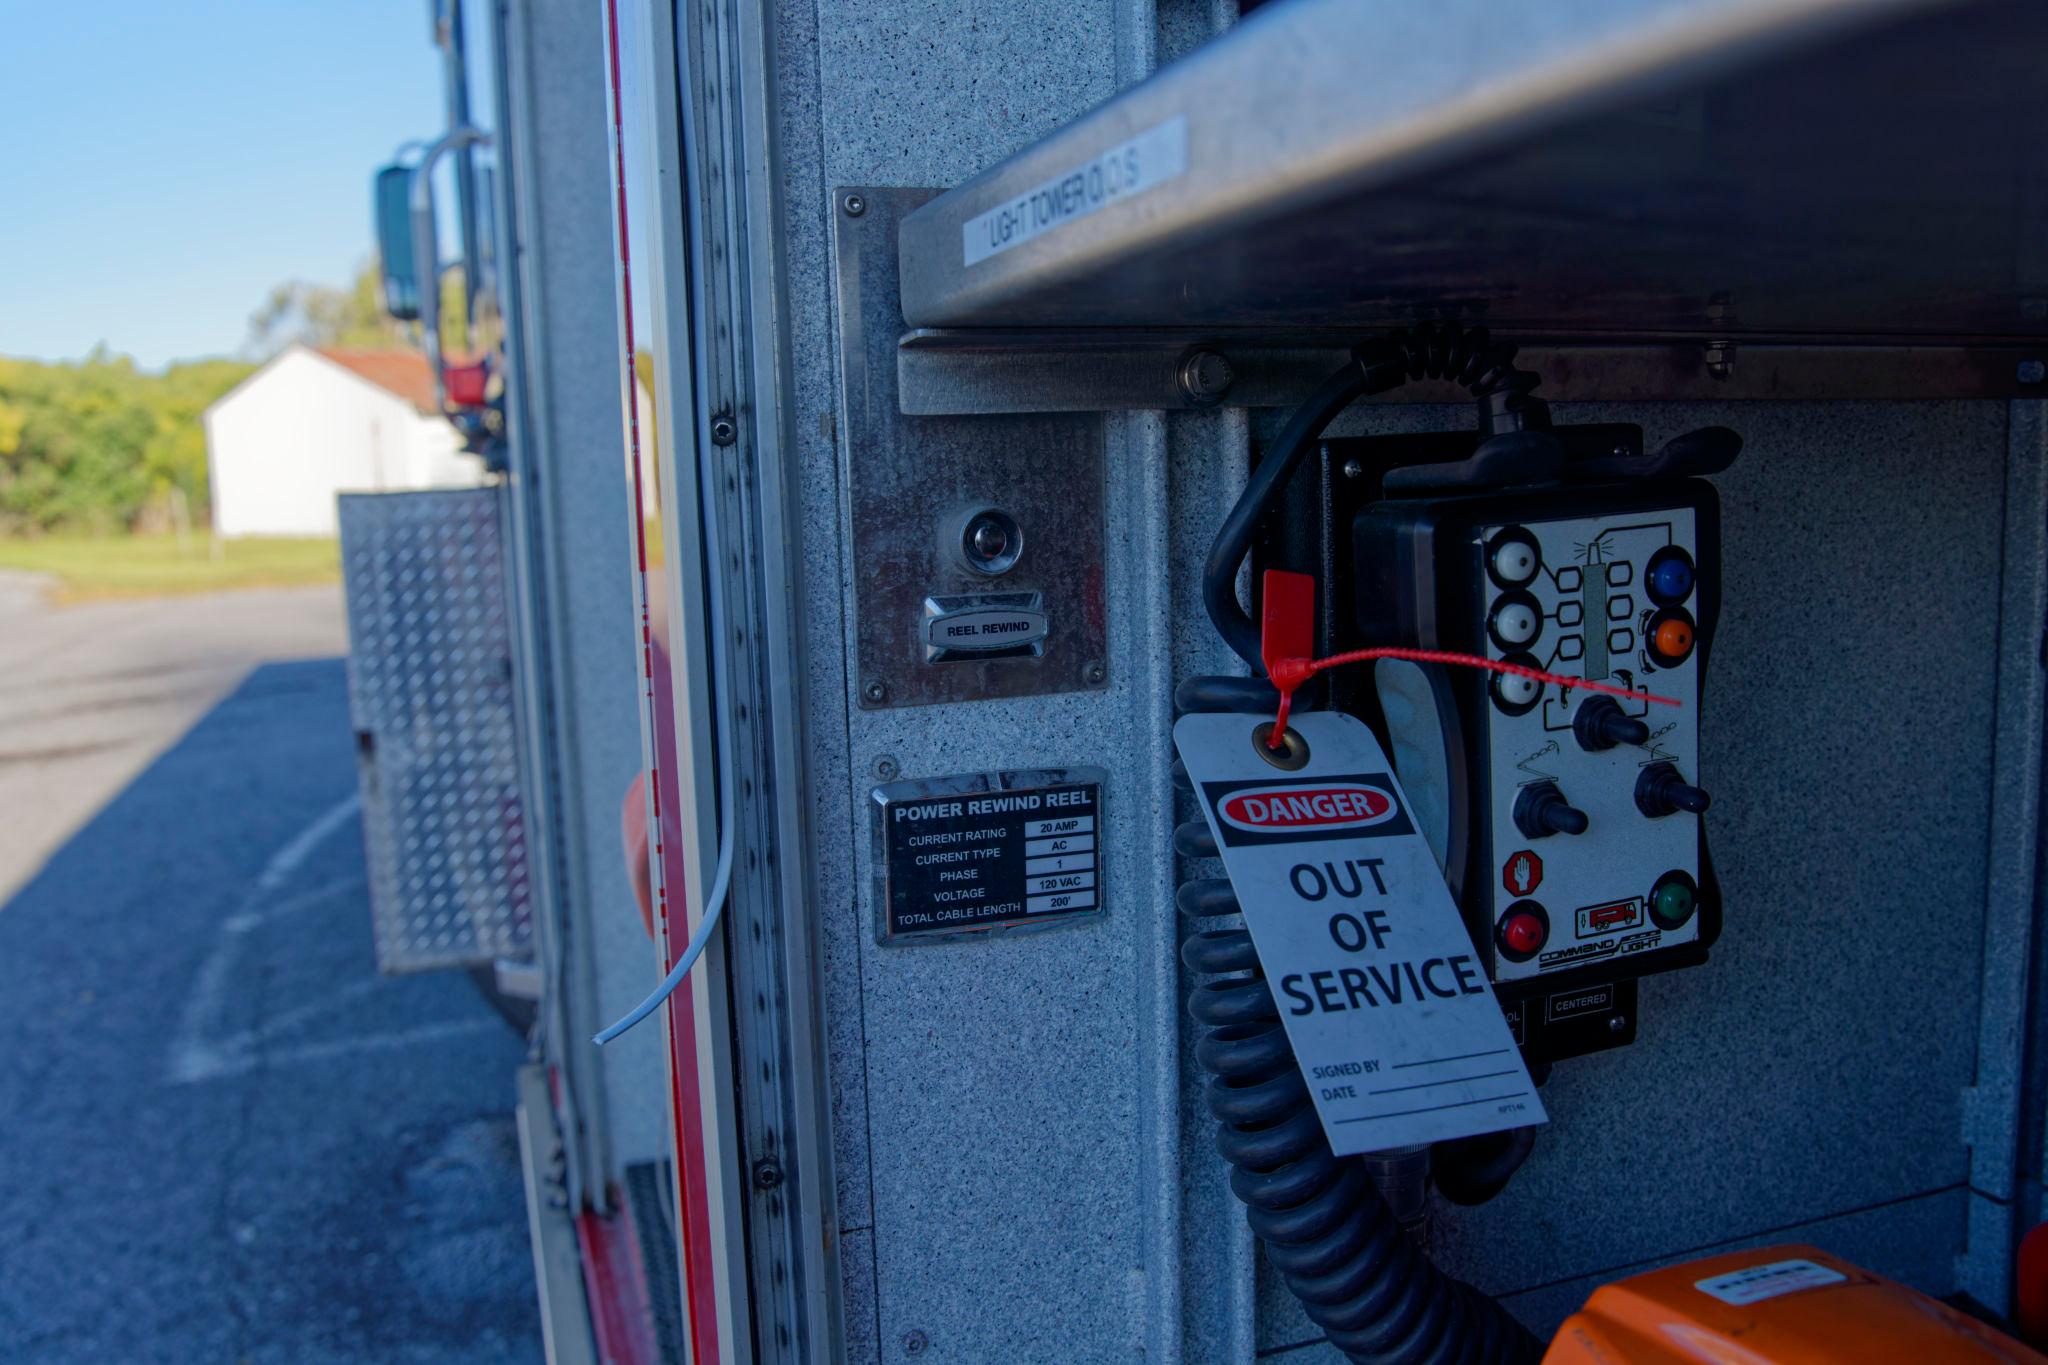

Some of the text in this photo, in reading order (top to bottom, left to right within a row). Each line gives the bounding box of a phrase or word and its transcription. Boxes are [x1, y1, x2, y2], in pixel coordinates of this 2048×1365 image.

[1030, 172, 1086, 226] TOWER
[948, 621, 1030, 637] REEL REWIND
[895, 790, 1091, 822] POWER REWIND REEL
[1241, 792, 1376, 824] DANGER
[1040, 820, 1078, 833] 20 AMP
[908, 828, 1007, 847] CURRENT RATING
[1051, 840, 1067, 850] AC
[915, 848, 1001, 866] CURRENT TYPE
[940, 869, 978, 882] PHASE
[1039, 876, 1081, 890] 120 VAC
[1288, 857, 1388, 902] OUT
[934, 888, 985, 902] VOLTAGE
[1050, 897, 1071, 908] 200'
[898, 902, 1021, 926] TOTAL CABLE LENGTH
[1328, 909, 1393, 953] OF
[1621, 938, 1659, 953] LIGHT
[1280, 954, 1485, 1017] SERVICE
[1555, 993, 1607, 1012] CENTERED
[1312, 1060, 1380, 1080] SIGNED BY
[1321, 1085, 1357, 1101] DATE
